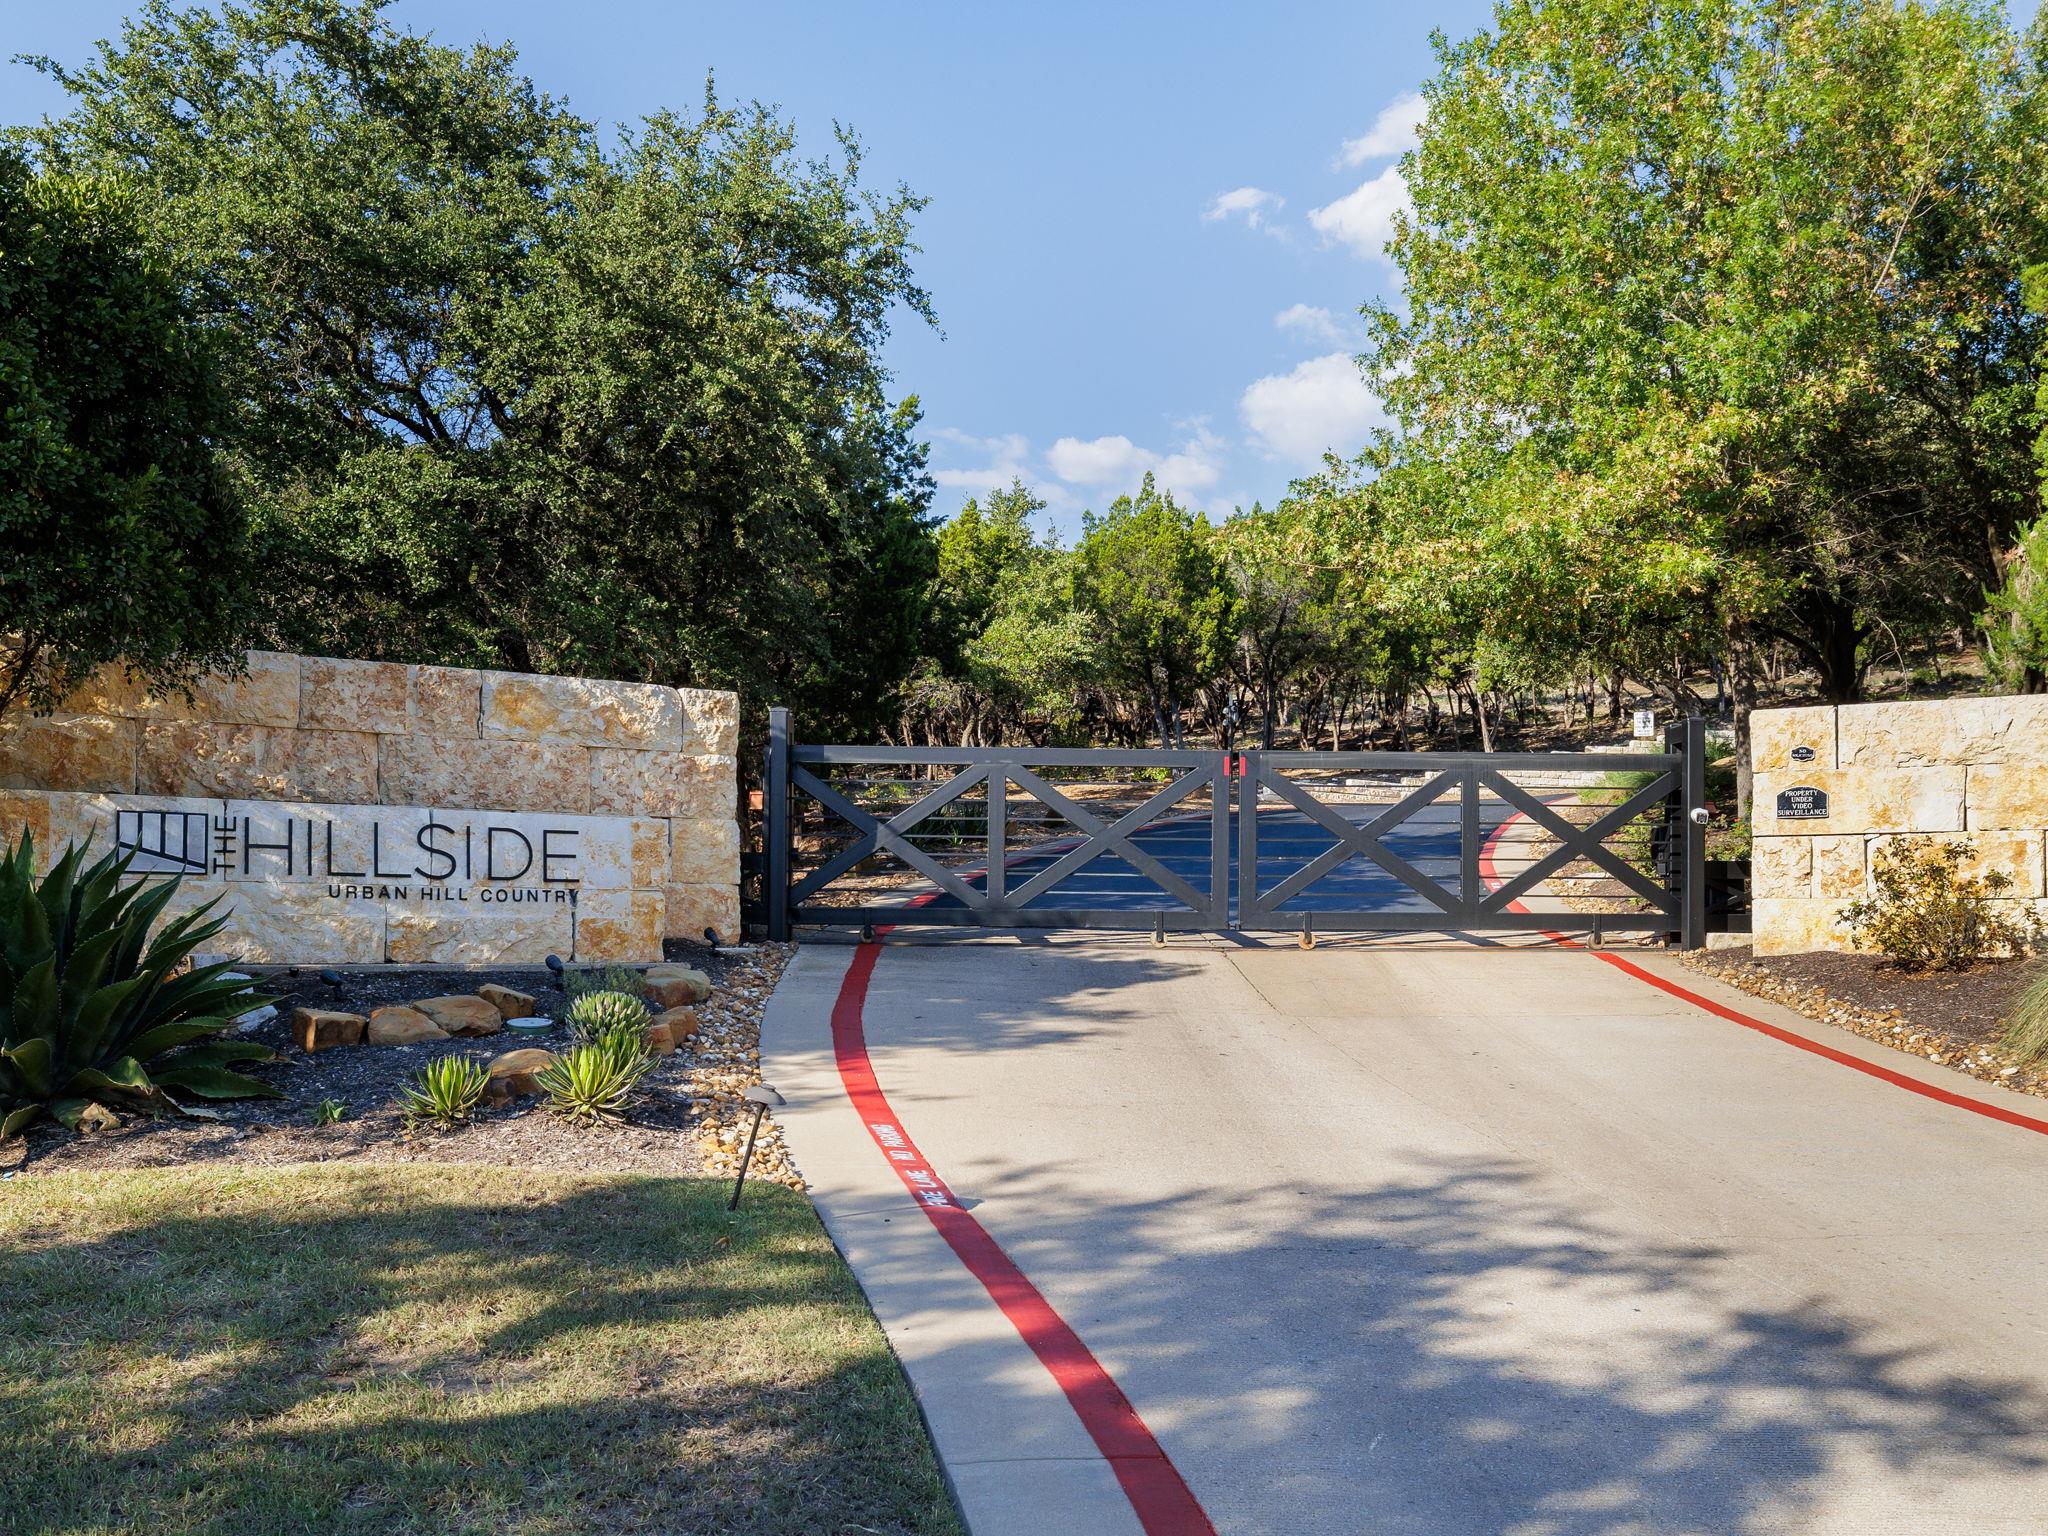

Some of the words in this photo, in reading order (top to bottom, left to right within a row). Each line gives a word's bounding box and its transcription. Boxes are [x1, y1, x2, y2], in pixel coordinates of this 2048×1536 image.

[213, 815, 238, 874] THE
[244, 816, 580, 883] HILLSIDE
[328, 884, 408, 900] URBAN
[421, 887, 468, 901] HILL
[480, 889, 579, 903] COUNTRY
[888, 1150, 917, 1161] NO
[906, 1169, 938, 1188] LANE
[919, 1190, 952, 1208] FIRE
